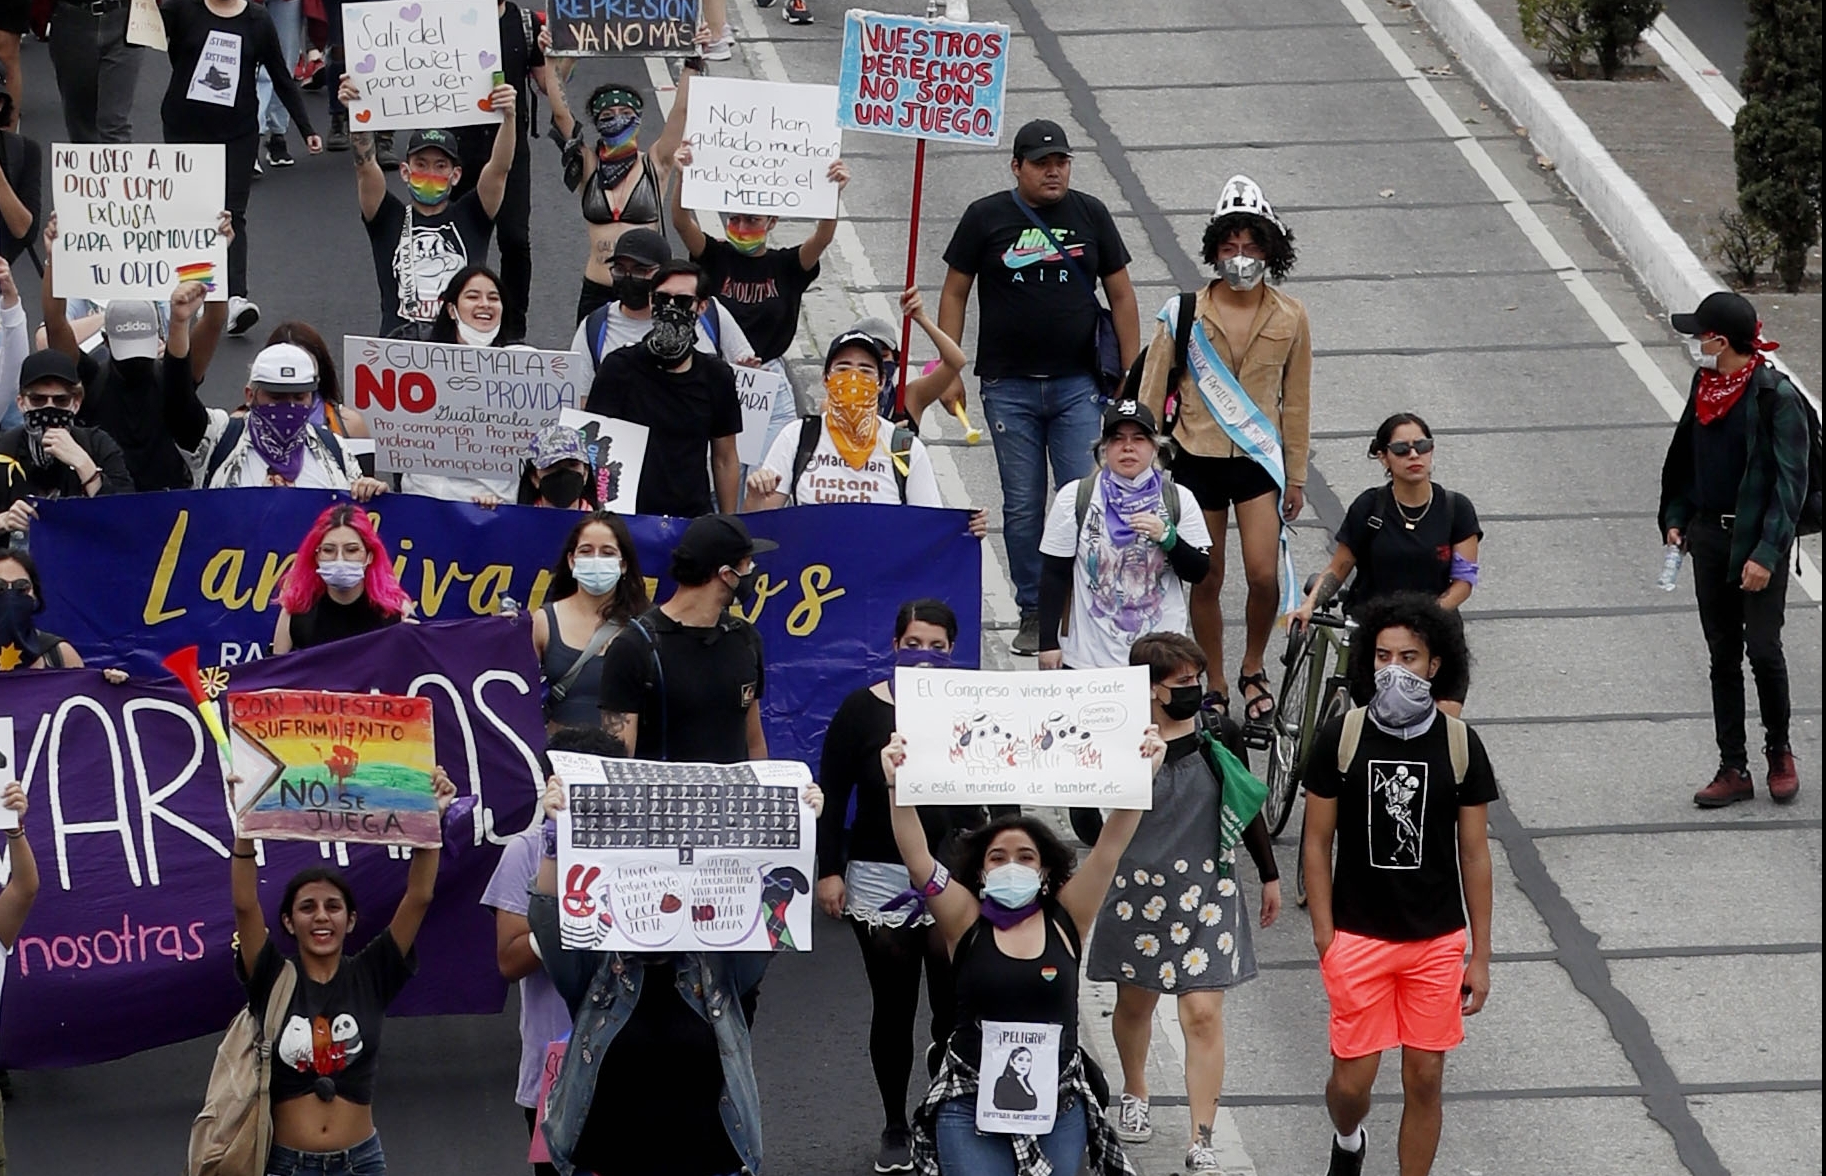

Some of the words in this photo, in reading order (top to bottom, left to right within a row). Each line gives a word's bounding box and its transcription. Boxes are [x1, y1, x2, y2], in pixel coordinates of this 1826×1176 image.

[408, 16, 446, 45] del
[569, 22, 600, 52] YA
[604, 22, 643, 52] NO
[649, 18, 694, 48] MÁS
[860, 23, 1003, 59] NUESTROS
[385, 47, 468, 73] closet
[862, 53, 994, 86] DERECHOS
[366, 74, 415, 96] para
[432, 73, 473, 91] ser
[860, 75, 899, 102] NO
[916, 79, 974, 107] SON
[381, 92, 471, 117] LIBRE
[771, 106, 812, 133] han
[855, 103, 893, 126] UN
[898, 100, 996, 139] JUEGO.
[689, 128, 763, 152] quitado
[55, 150, 79, 171] NO
[90, 149, 133, 174] USES
[148, 149, 161, 171] A
[176, 150, 193, 173] TU
[64, 174, 110, 199] DIOS
[123, 176, 174, 201] COMO
[689, 166, 790, 193] incluyendo
[795, 171, 813, 191] el
[724, 189, 801, 208] MIEDO
[65, 231, 113, 252] PARA
[125, 228, 217, 254] PROMOVER
[92, 264, 111, 285] TU
[121, 260, 170, 288] ODIO
[115, 320, 153, 333] adidas
[385, 344, 546, 377] GUATEMALA
[354, 364, 437, 414] NO
[446, 376, 482, 392] es
[485, 380, 576, 412] PROVIDA
[434, 405, 535, 429] Guatemala
[809, 475, 880, 492] Instant
[917, 678, 933, 697] El
[944, 679, 1011, 705] Congreso
[1020, 681, 1062, 697] viendo
[1066, 685, 1084, 701] que
[303, 696, 416, 717] NUESTRO
[254, 719, 405, 741] SUFRIMIENTO
[280, 777, 330, 809] NO
[965, 780, 1016, 794] muriendo
[1027, 780, 1044, 794] de
[305, 810, 405, 835] JUEGA
[17, 911, 206, 975] nosotras
